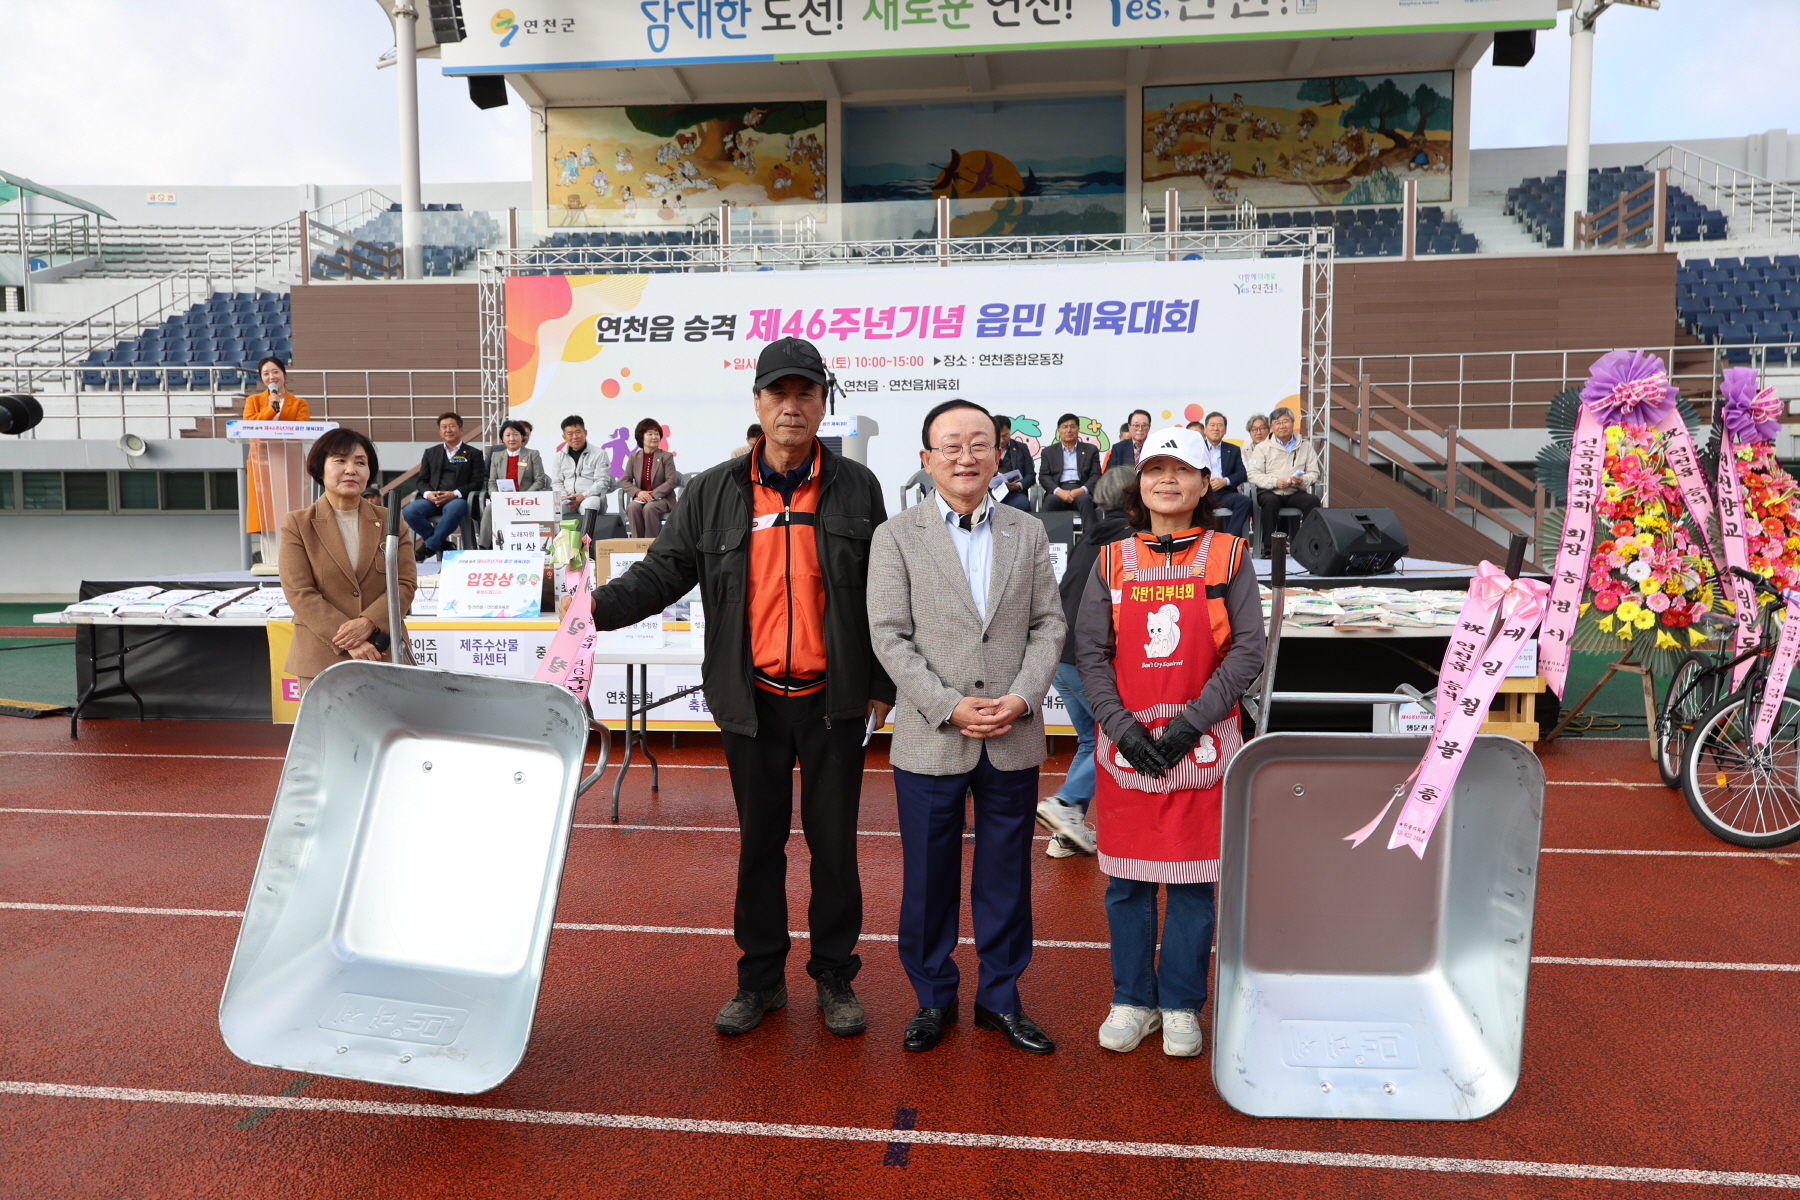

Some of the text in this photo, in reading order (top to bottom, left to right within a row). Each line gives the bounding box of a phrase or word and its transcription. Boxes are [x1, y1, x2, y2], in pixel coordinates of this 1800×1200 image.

[524, 18, 575, 34] 연천군
[597, 299, 1200, 342] 연천읍 승격 제46주년기념 읍민 체육대회
[855, 355, 924, 368] 10:00~15:00
[943, 355, 967, 367] 장소
[979, 353, 1064, 366] 연천종합운동장
[844, 380, 878, 392] 연천읍
[889, 379, 960, 392] 연천읍체육회
[505, 497, 540, 506] Tefal
[1719, 453, 1743, 538] 연천향교
[1563, 528, 1586, 556] 회장
[467, 573, 514, 587] 입장상
[1461, 621, 1486, 636] 祝
[411, 639, 437, 651] 이즈
[460, 638, 518, 652] 제주수산물
[472, 653, 507, 665] 회센터
